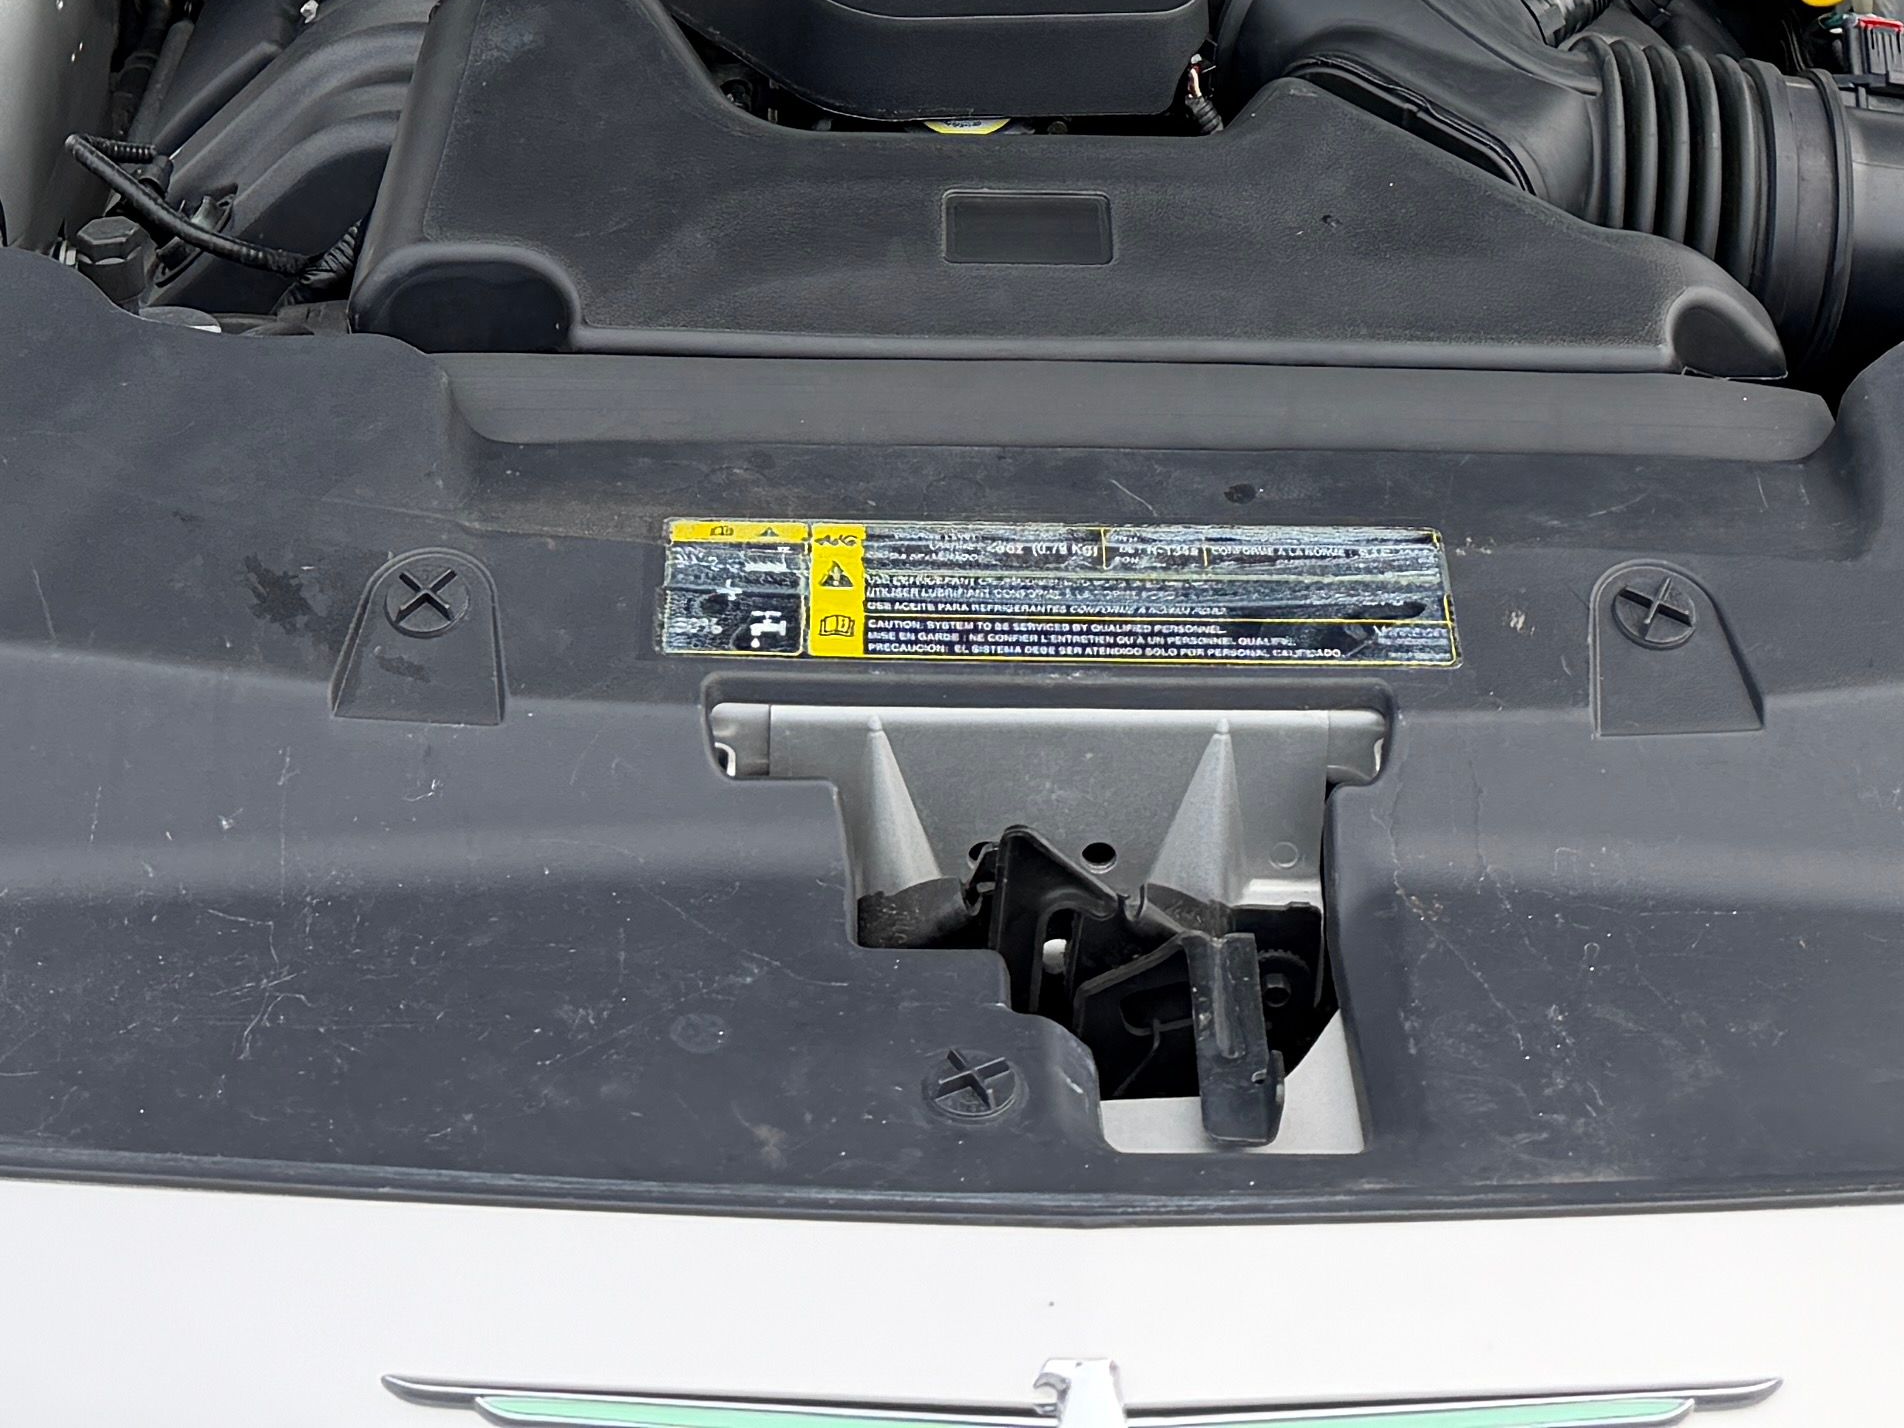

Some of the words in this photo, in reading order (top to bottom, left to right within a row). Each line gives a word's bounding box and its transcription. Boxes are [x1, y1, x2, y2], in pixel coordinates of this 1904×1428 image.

[894, 601, 936, 612] ACEITE
[937, 602, 970, 612] PARA
[971, 603, 1067, 615] REFRIGERANTES
[926, 620, 975, 631] SYSTEM
[977, 621, 993, 631] TO
[994, 621, 1011, 631] BE
[1012, 622, 1070, 633] SERVICED
[1072, 623, 1088, 633] BY
[1090, 623, 1152, 634] QUALIFIED
[1154, 624, 1228, 635] PERSONNEL.
[867, 631, 897, 641] MISE
[899, 631, 916, 641] EN
[917, 631, 961, 642] GARDE
[968, 632, 986, 642] NE
[987, 633, 1038, 643] CONFIER
[1040, 634, 1115, 645] L'ENTRETIEN
[1147, 635, 1165, 645] UN
[1167, 636, 1236, 646] PERSONNEL
[953, 644, 970, 654] EL
[971, 644, 1022, 655] SISTEMA
[1023, 645, 1056, 656] DEBE
[1058, 646, 1083, 656] SER
[1084, 646, 1143, 657] ATENDIDO
[1144, 647, 1178, 657] SOLO
[1179, 647, 1205, 657] POR
[1207, 647, 1270, 658] PERSONAL
